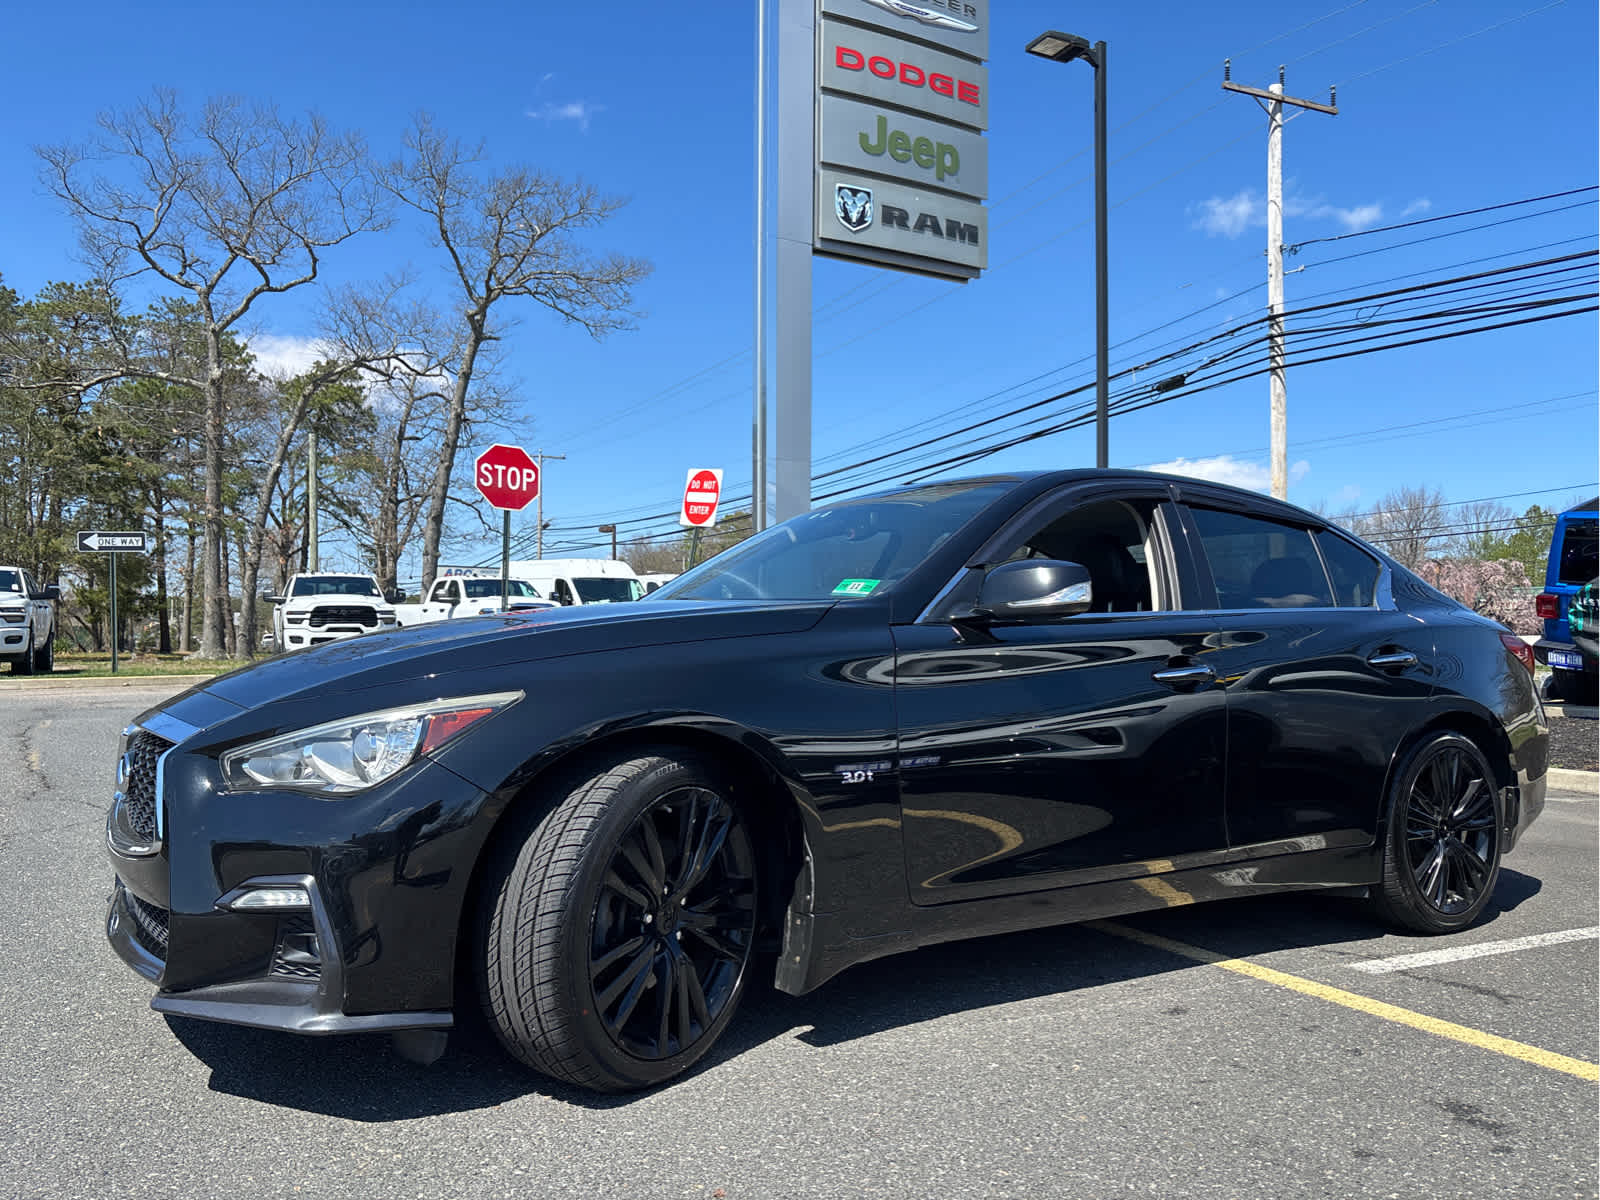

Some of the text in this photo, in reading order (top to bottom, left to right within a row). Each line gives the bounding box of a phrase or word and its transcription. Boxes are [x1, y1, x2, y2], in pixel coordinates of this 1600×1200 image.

[836, 46, 980, 105] DODGE
[859, 115, 960, 180] Jeep
[881, 204, 979, 244] RAM
[480, 462, 536, 491] STOP
[691, 480, 717, 490] DO NOT
[689, 504, 710, 515] ENTER
[98, 537, 141, 546] ONE WAY
